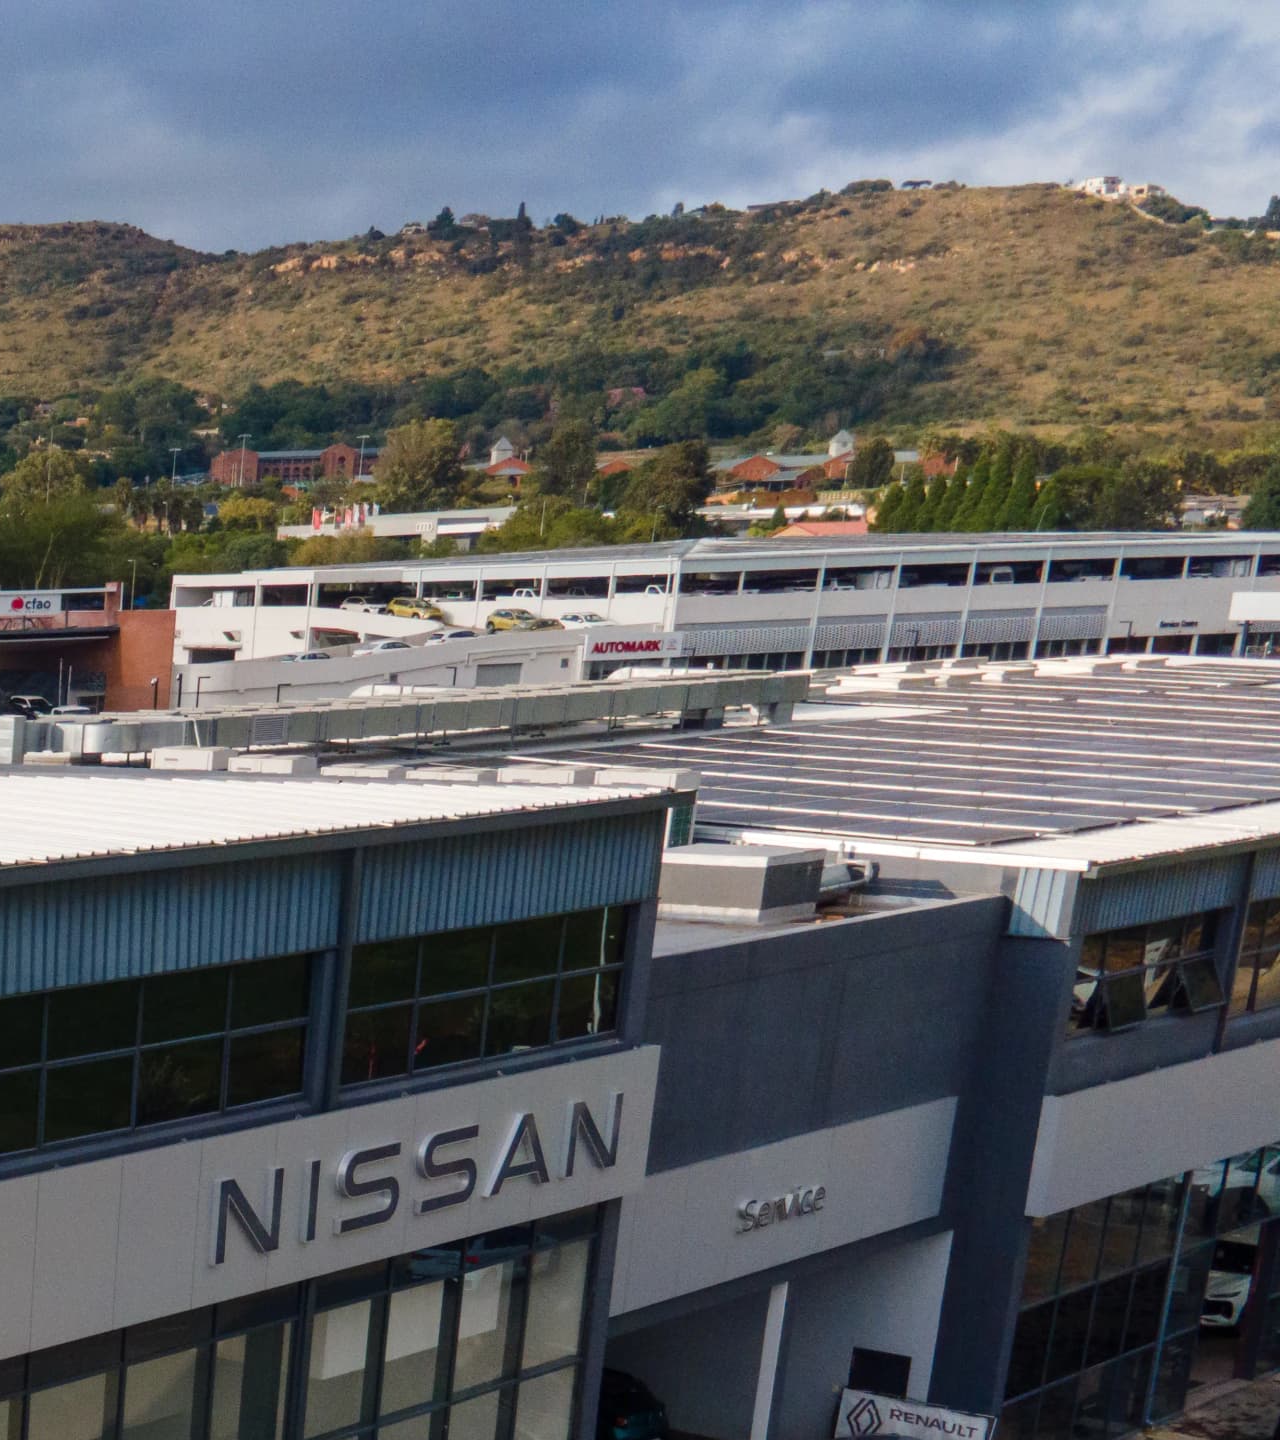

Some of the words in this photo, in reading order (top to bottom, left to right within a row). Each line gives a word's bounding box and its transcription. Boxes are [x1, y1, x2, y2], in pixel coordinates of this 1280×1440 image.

[25, 598, 51, 609] cfao
[591, 640, 662, 654] AUTOMARK
[209, 1091, 625, 1266] NISSAN
[736, 1185, 826, 1234] Service
[889, 1408, 979, 1439] RENAULT
